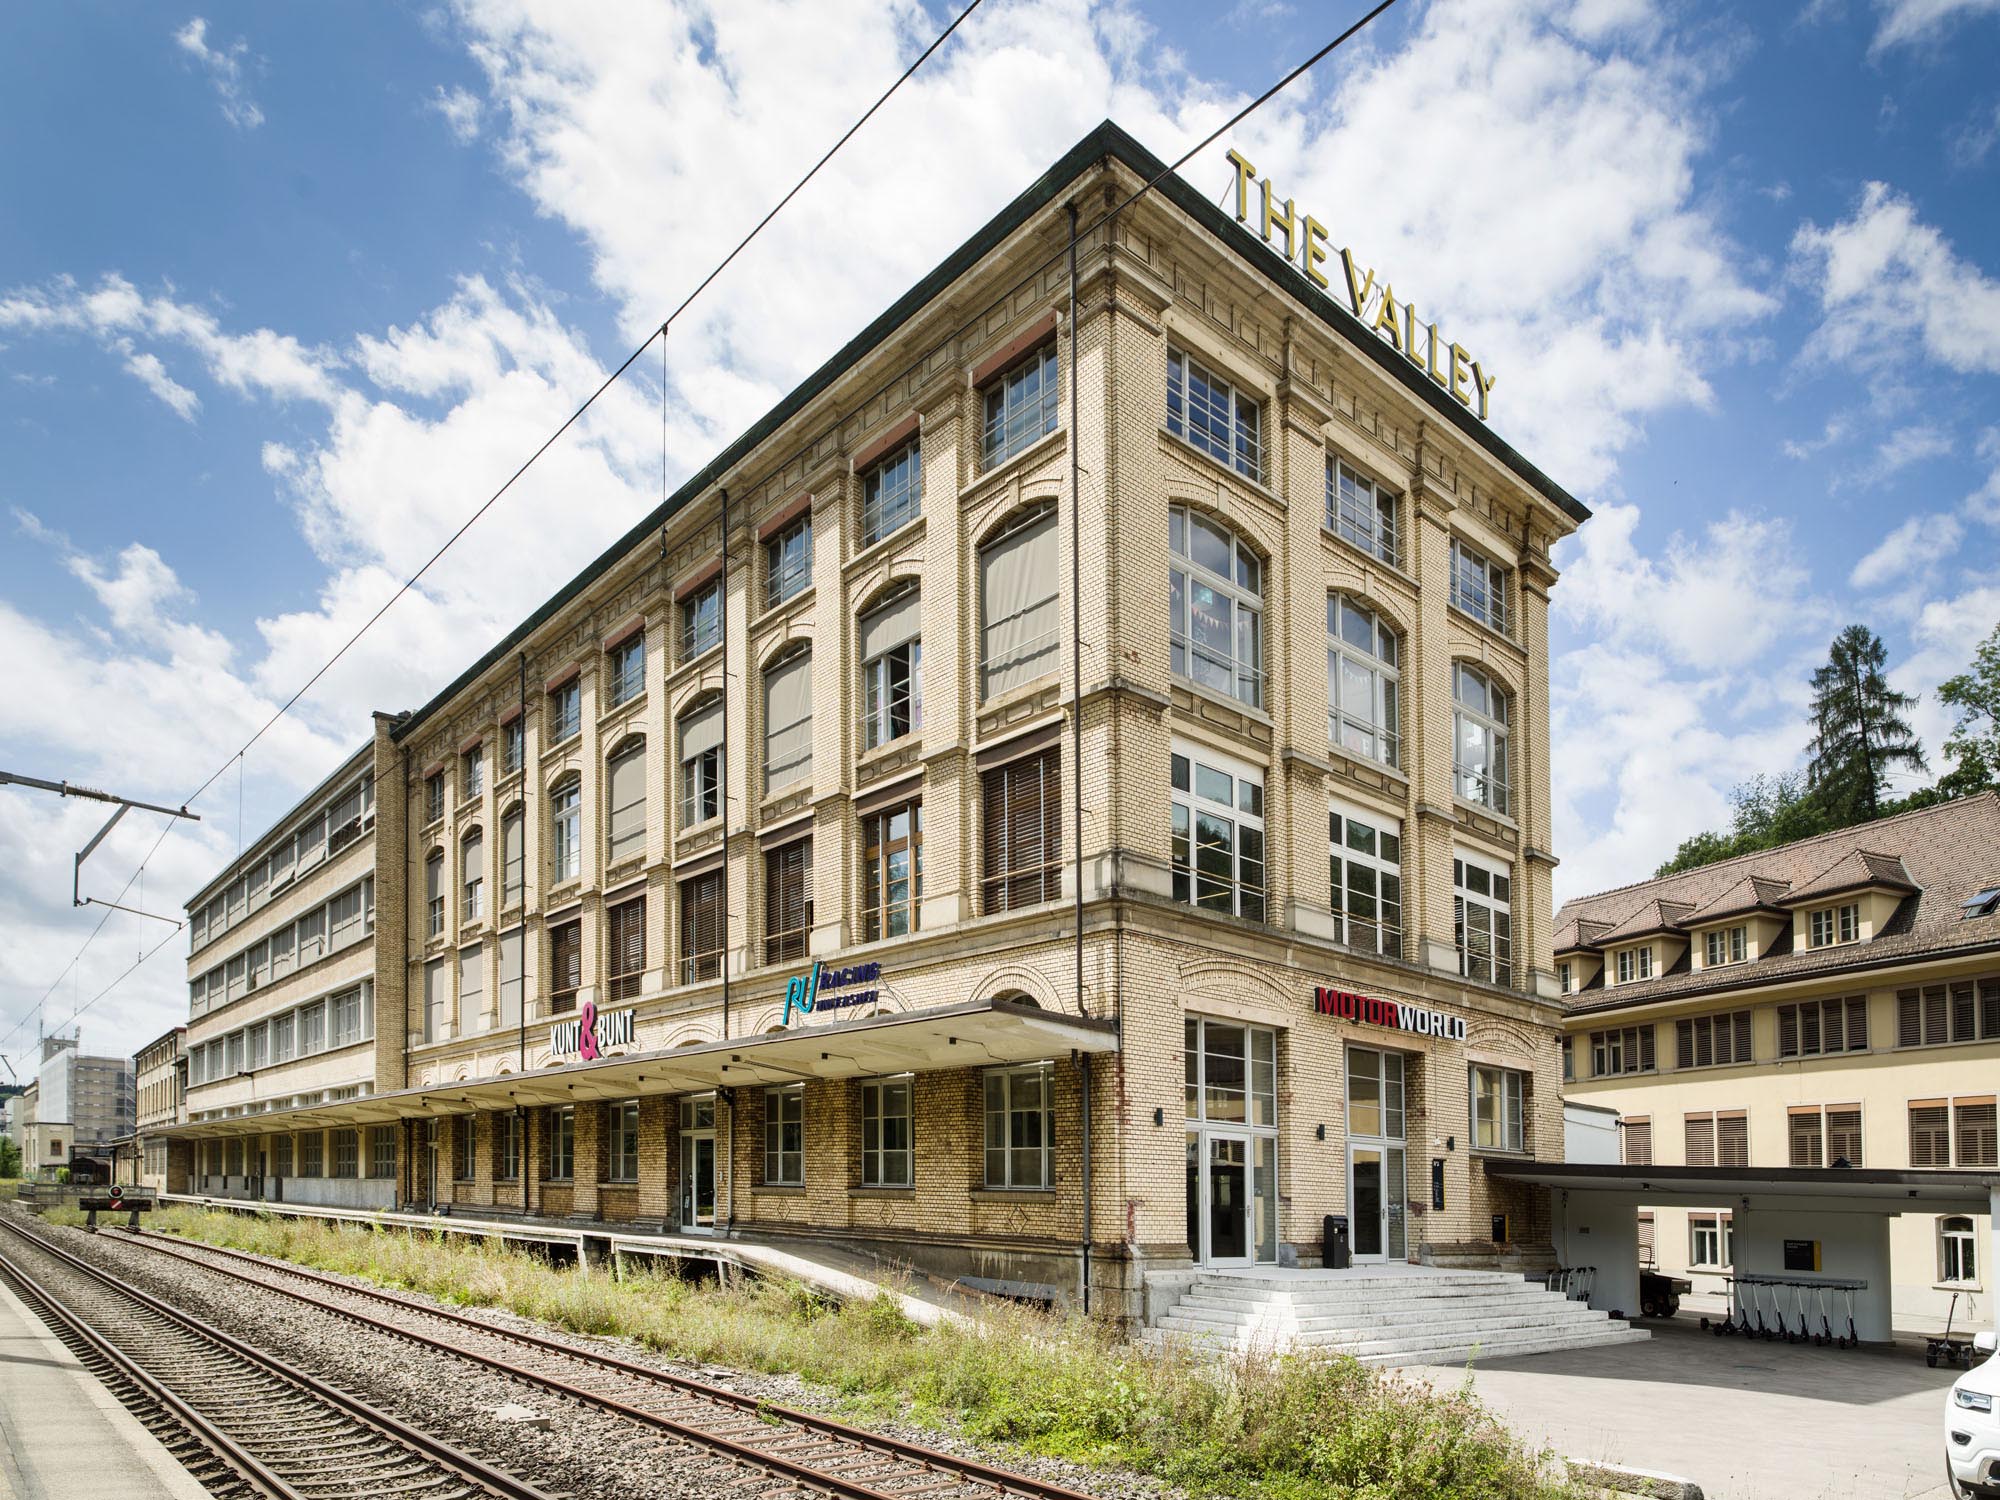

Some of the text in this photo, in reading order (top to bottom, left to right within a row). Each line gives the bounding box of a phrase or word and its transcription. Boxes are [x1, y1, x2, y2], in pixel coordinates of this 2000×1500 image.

[1226, 148, 1496, 421] THE VALLEY
[819, 962, 880, 991] RACING
[1314, 986, 1467, 1042] MOTORWORLD
